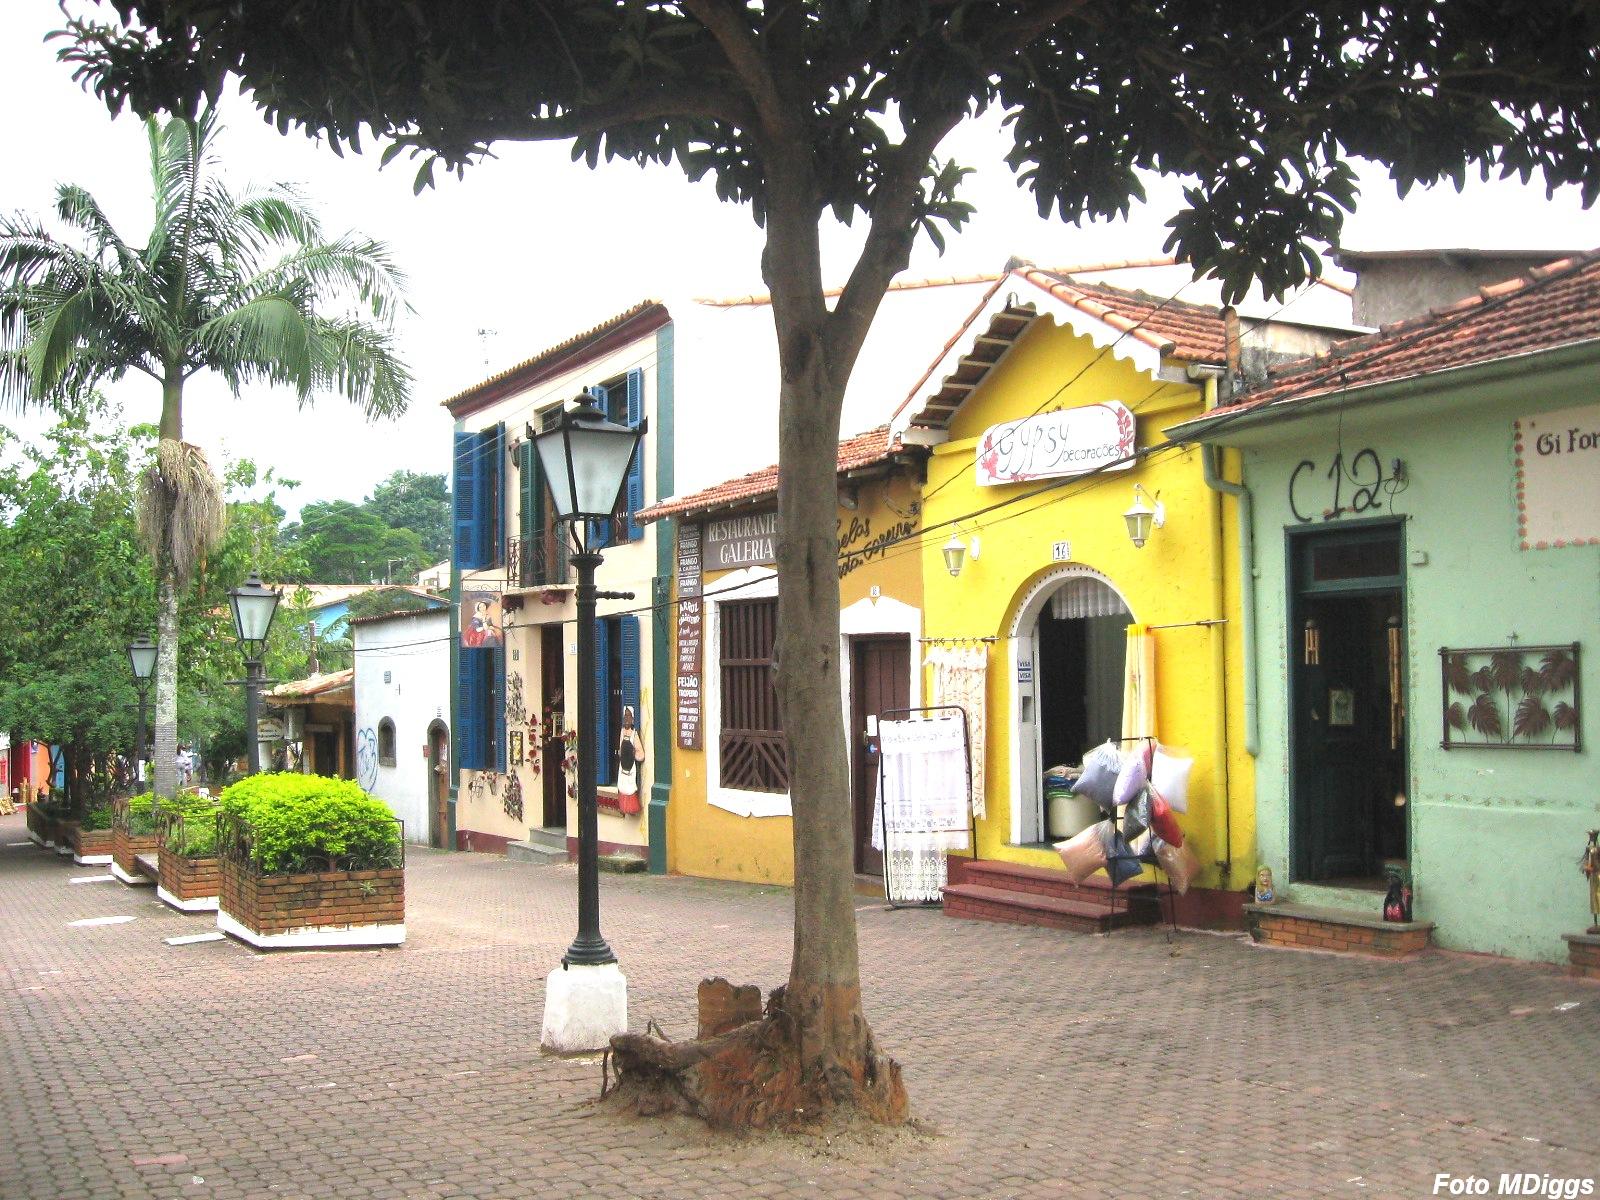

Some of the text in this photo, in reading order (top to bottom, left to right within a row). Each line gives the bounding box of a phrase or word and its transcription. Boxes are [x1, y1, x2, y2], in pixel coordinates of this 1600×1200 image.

[1000, 423, 1069, 475] Gypsy
[1537, 432, 1561, 456] Gi
[708, 512, 778, 542] RESTAURANTE
[680, 557, 698, 566] FRANGO
[720, 538, 774, 564] GALERIA
[680, 579, 698, 588] FRANGO
[677, 675, 698, 688] FEIJÃO
